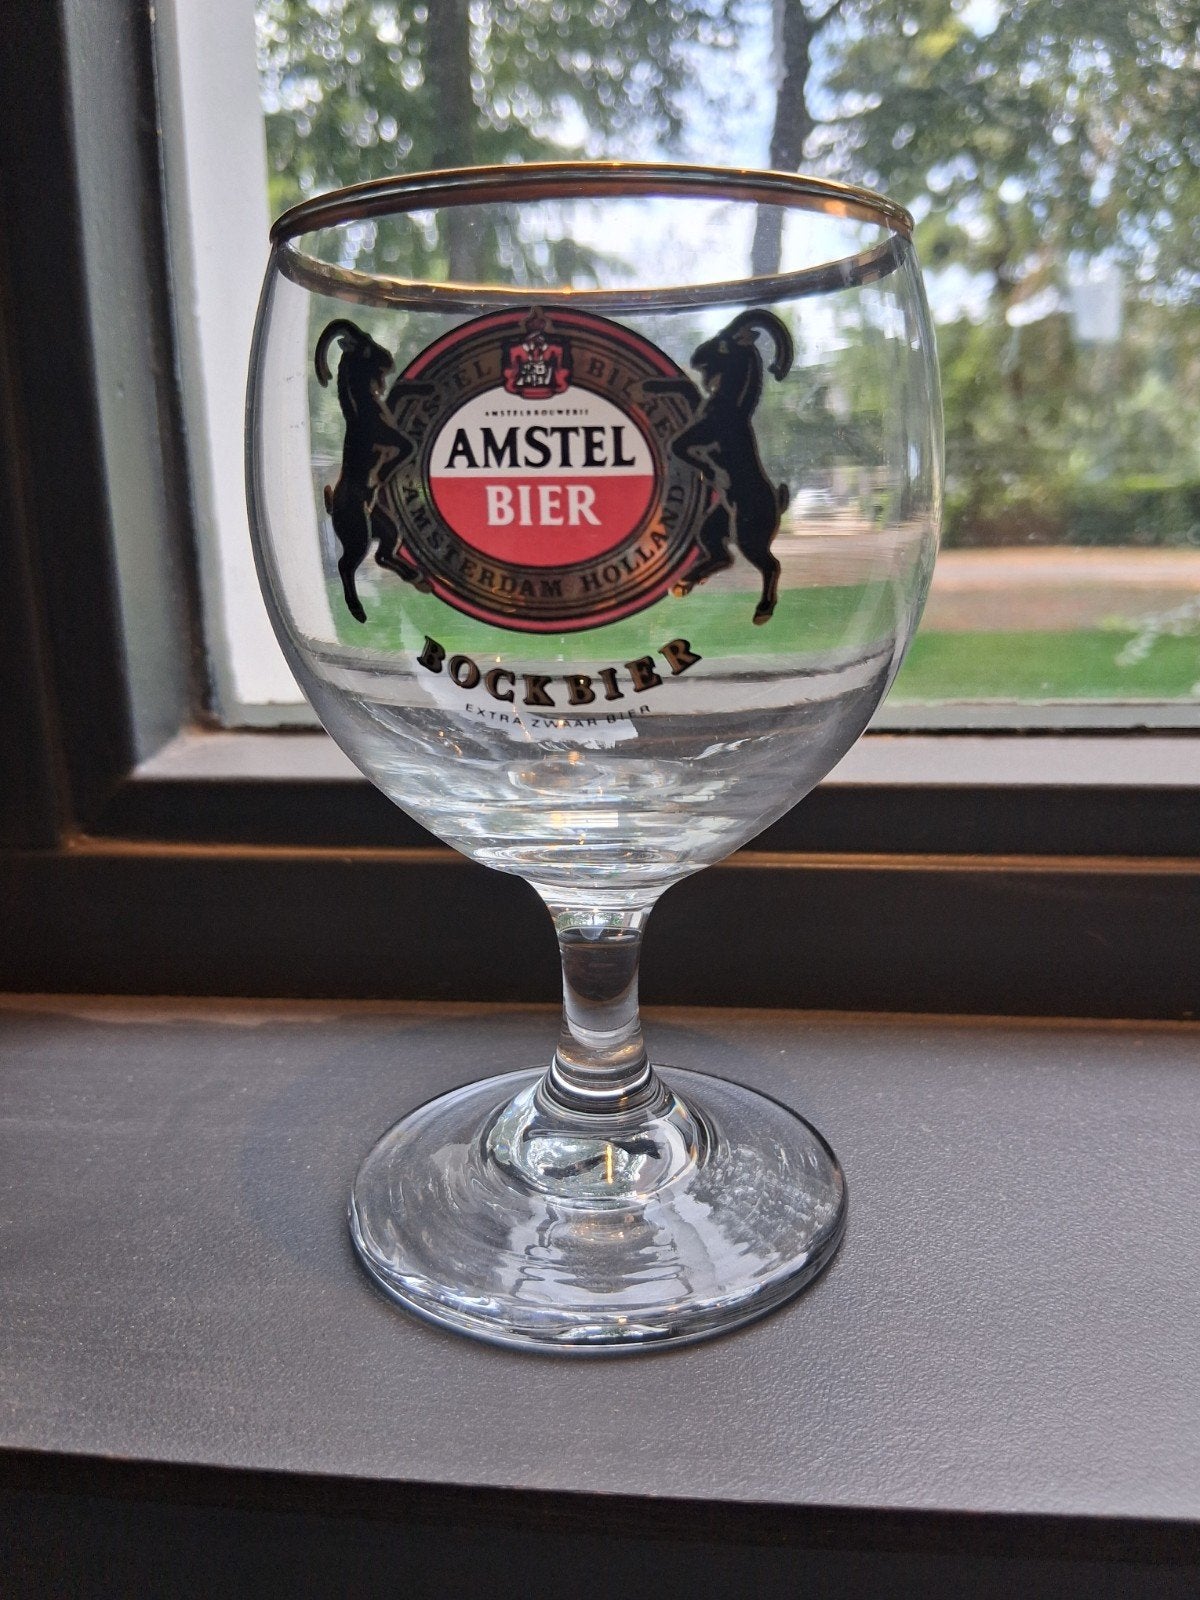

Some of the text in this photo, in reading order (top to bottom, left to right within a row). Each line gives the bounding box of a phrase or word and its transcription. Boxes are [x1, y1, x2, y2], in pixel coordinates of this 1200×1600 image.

[444, 425, 636, 469] AMSTEL
[485, 484, 602, 527] BIER
[402, 485, 685, 598] AMSTERDAM HOLLAND
[416, 635, 703, 707] BOCKBIER
[465, 703, 651, 729] EXTRA ZWAAR BIER
